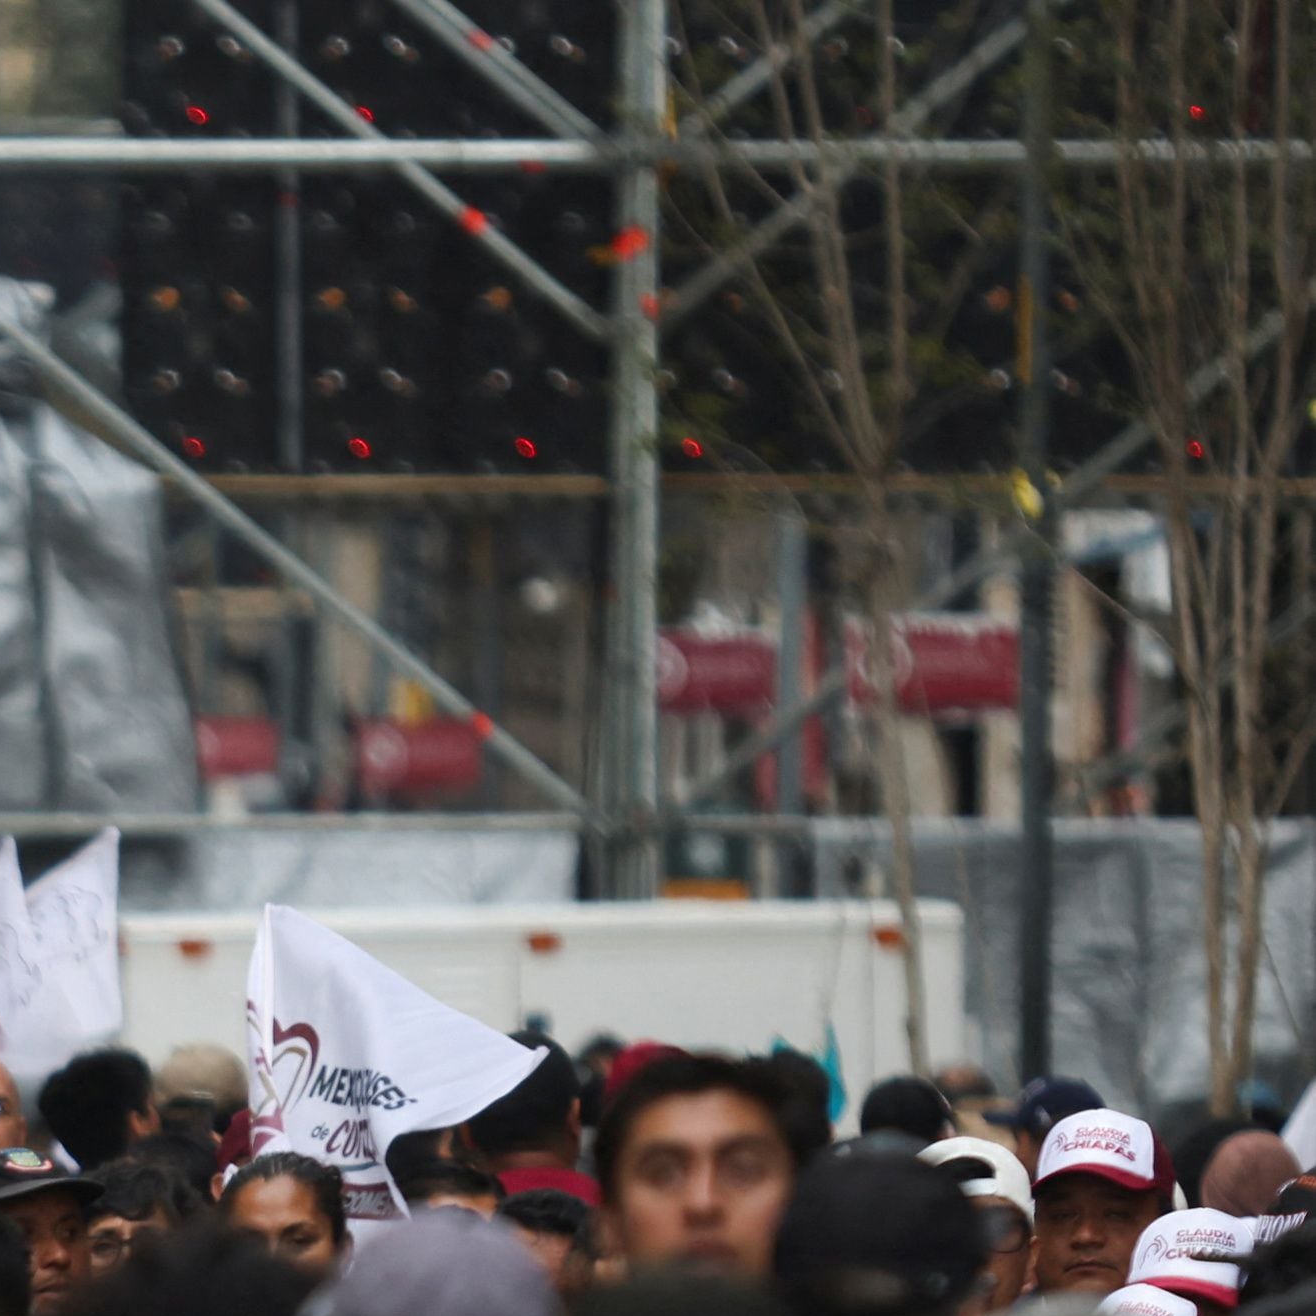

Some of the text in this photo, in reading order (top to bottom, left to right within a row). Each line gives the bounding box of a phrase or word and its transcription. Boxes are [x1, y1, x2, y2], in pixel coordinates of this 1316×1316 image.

[311, 1121, 331, 1141] de
[1064, 1140, 1137, 1162] CHIAPAS
[1176, 1228, 1236, 1242] CLAUDIA
